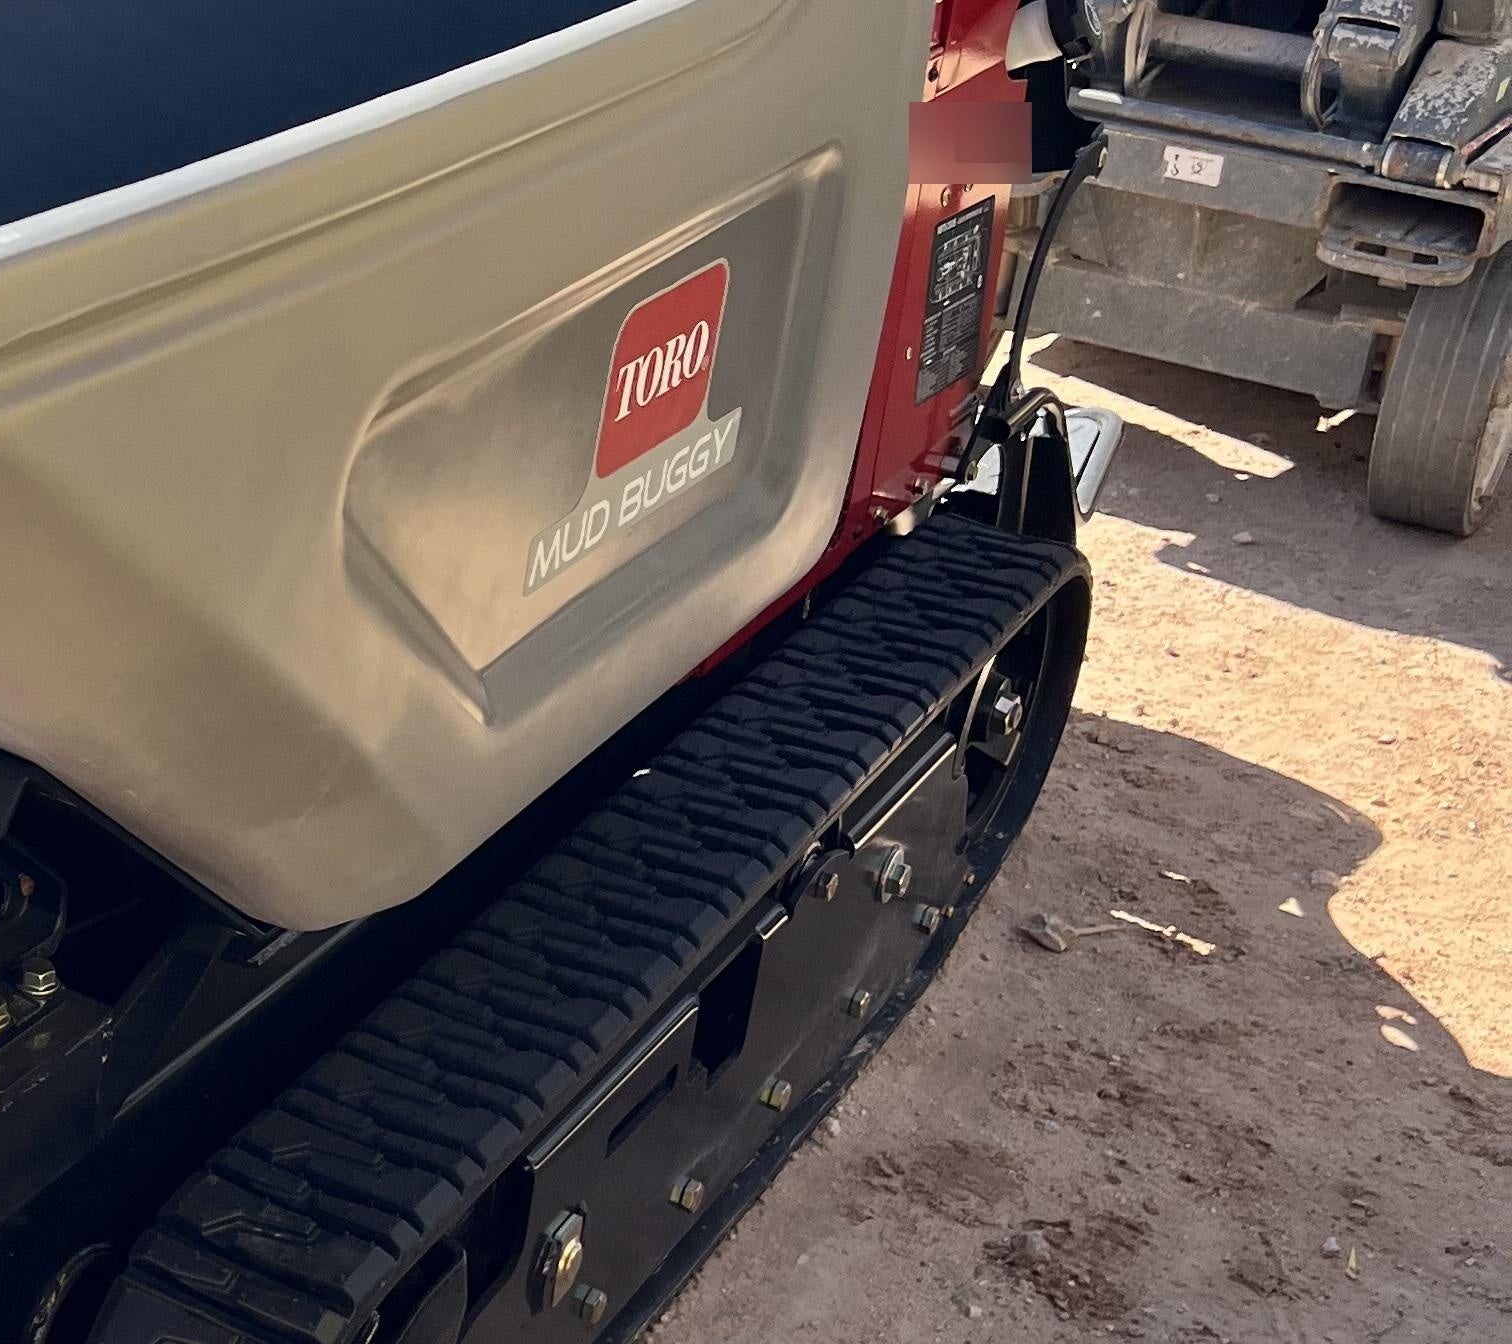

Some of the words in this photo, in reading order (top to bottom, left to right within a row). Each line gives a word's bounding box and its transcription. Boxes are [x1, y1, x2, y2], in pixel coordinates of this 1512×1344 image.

[614, 319, 710, 423] TORO
[527, 499, 610, 588] MUD
[617, 418, 734, 528] BUGGY
